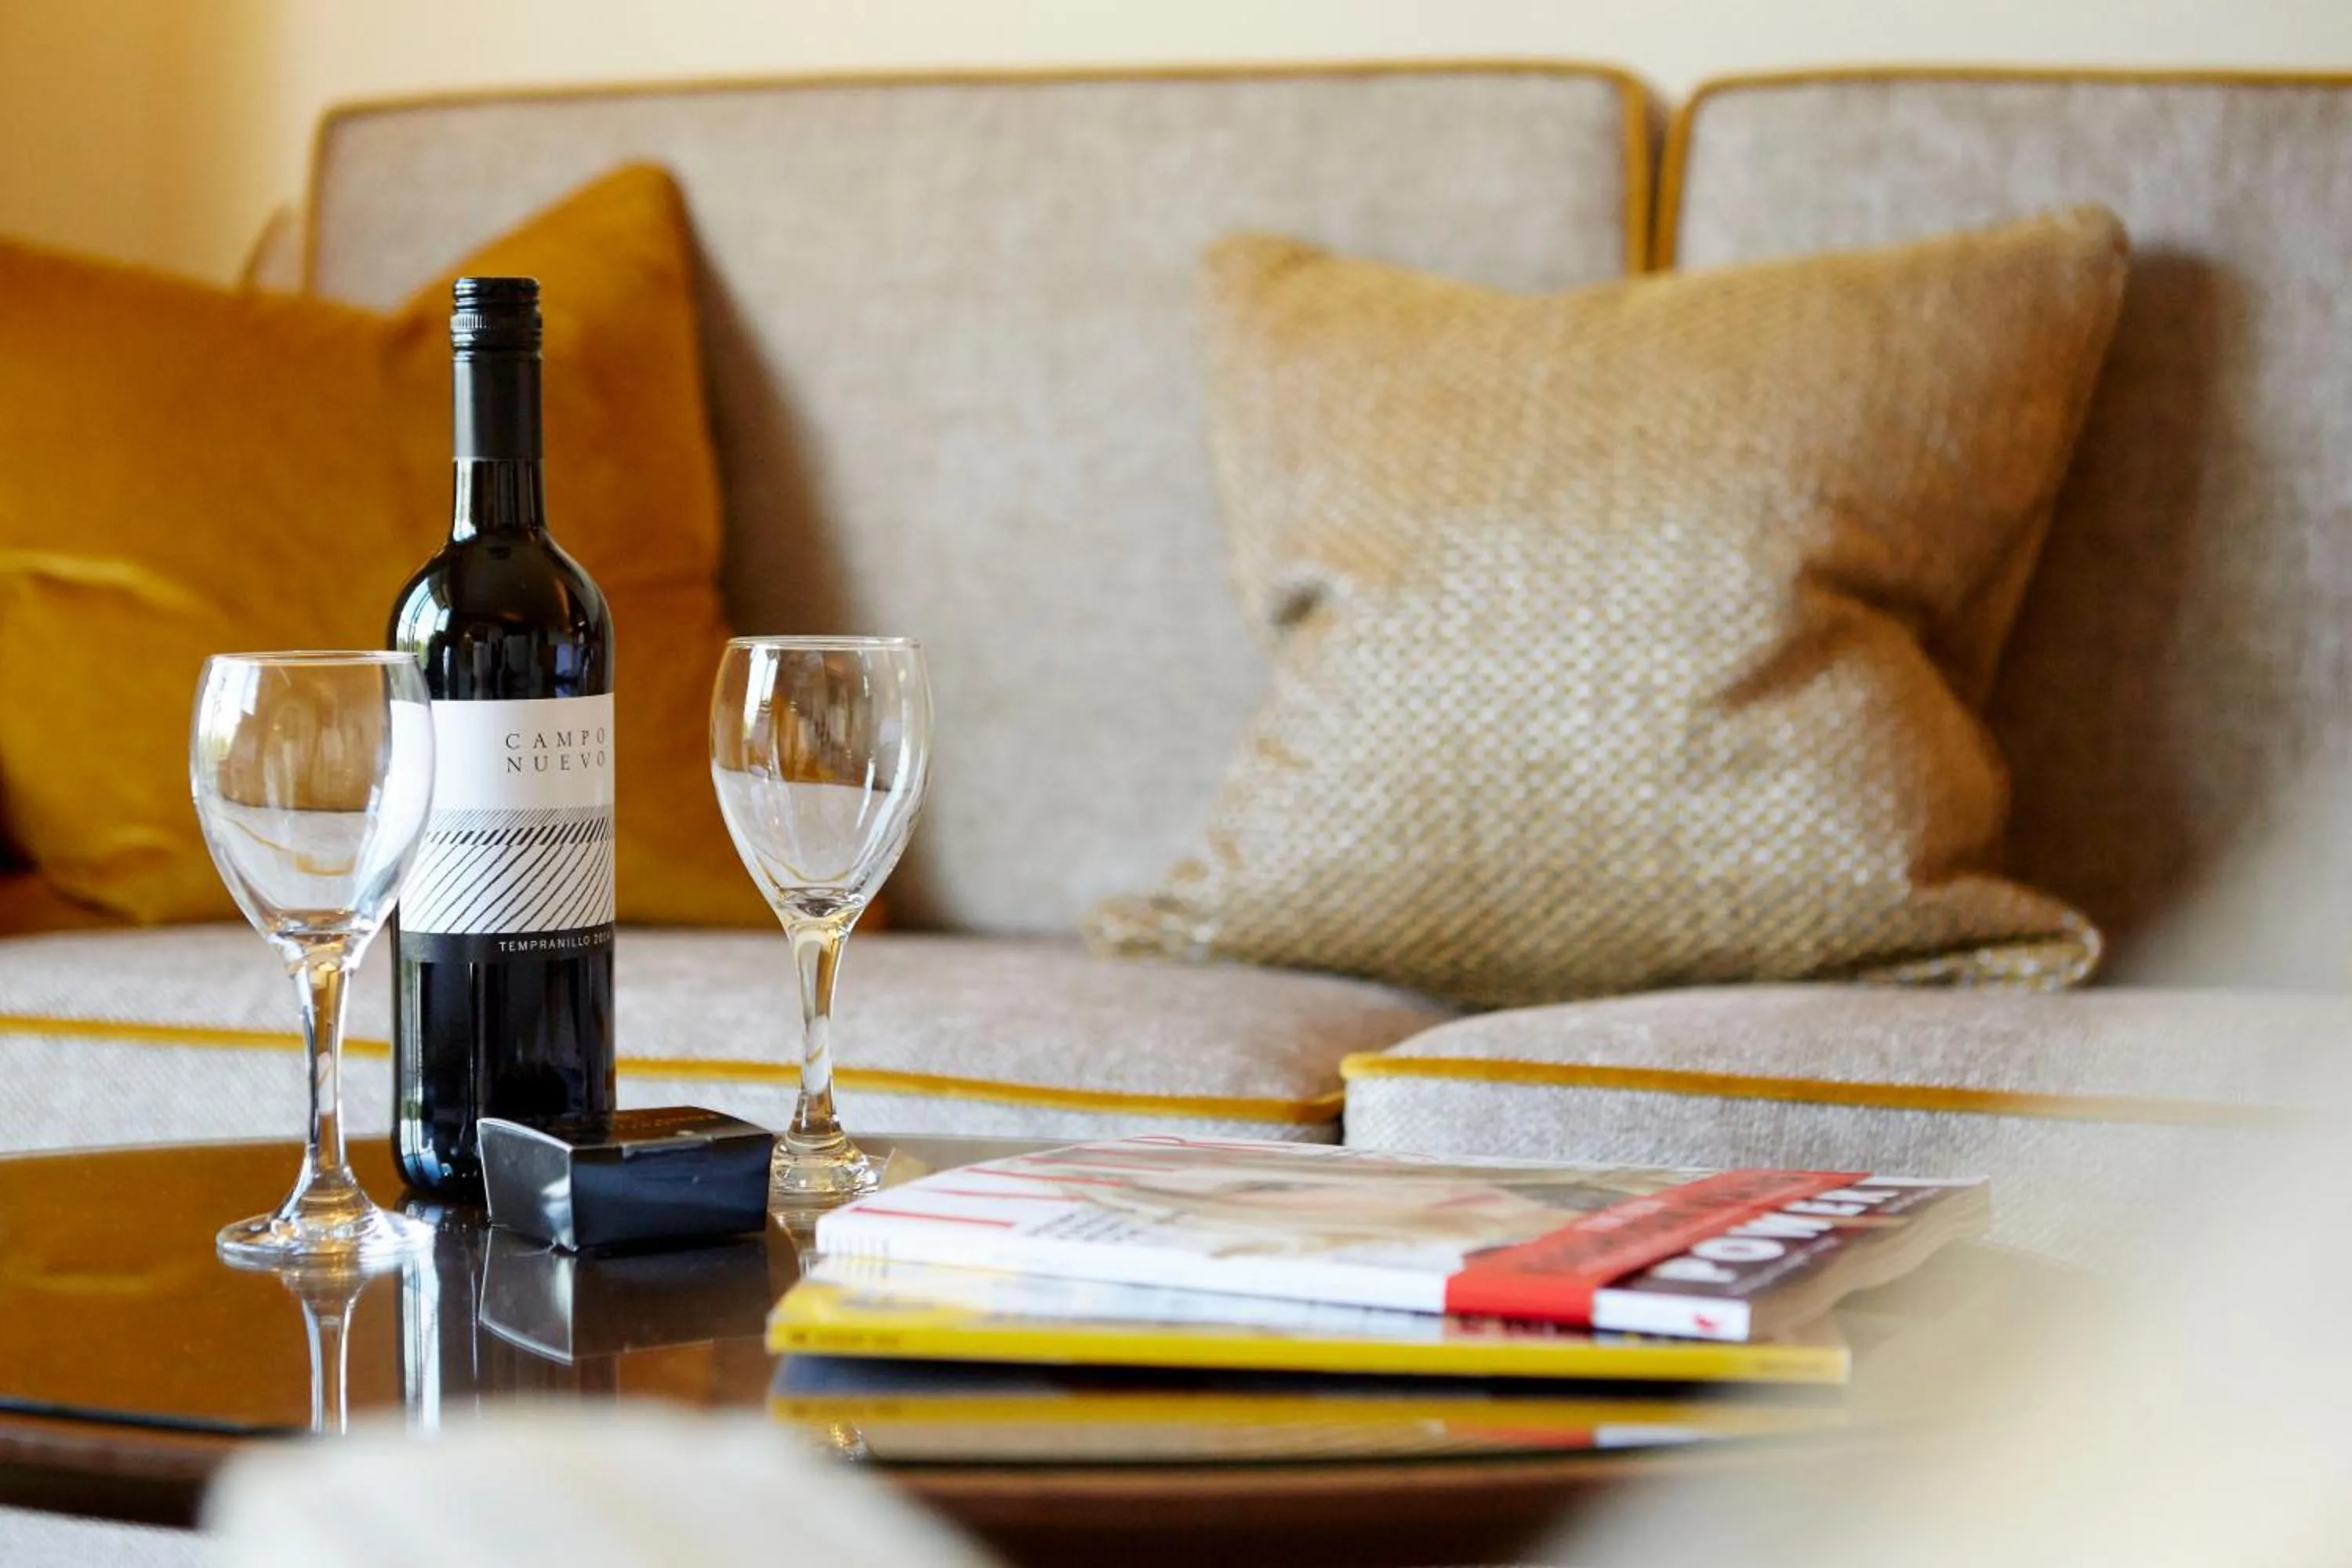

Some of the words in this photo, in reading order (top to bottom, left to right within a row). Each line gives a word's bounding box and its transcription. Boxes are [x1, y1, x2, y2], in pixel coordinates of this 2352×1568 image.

[506, 728, 604, 750] CAMPO
[507, 750, 604, 773] NUEVO
[499, 935, 590, 952] TEMPRANILLO
